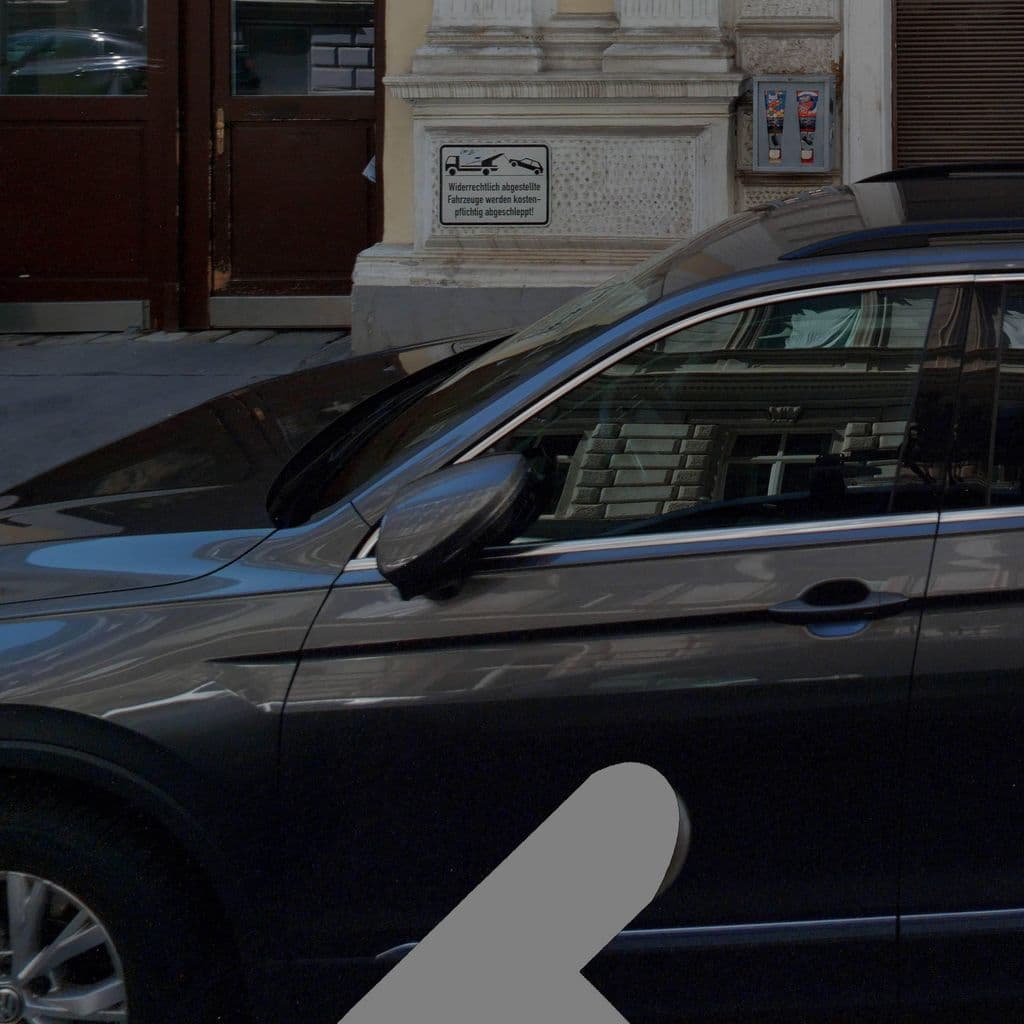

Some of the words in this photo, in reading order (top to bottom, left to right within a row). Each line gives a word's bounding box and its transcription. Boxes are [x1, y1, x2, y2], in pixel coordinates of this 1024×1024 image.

[448, 182, 500, 192] Widerrechtlich
[502, 182, 541, 193] abgestellte
[447, 195, 483, 206] Fahrzeuge
[483, 195, 512, 204] werden
[513, 195, 541, 204] kosten-
[454, 207, 483, 218] pflichtig
[484, 207, 534, 218] abgeschleppt!
